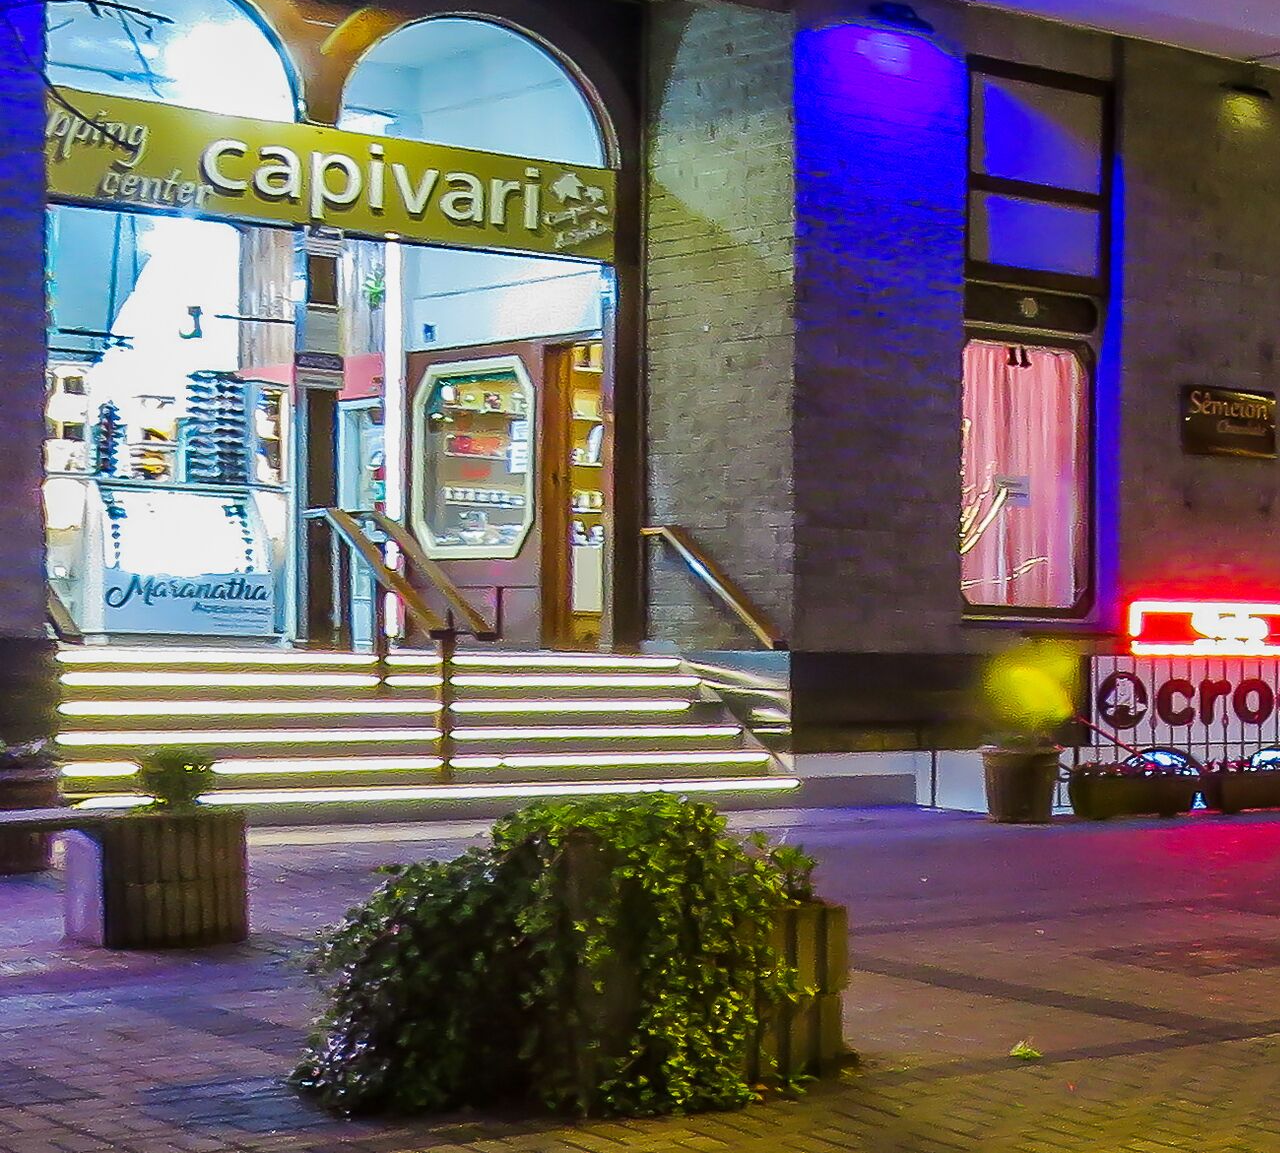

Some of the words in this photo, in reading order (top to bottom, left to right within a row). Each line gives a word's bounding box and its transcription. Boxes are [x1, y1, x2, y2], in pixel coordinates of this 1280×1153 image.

[99, 168, 214, 208] center
[200, 138, 542, 232] capivari
[105, 574, 270, 608] Maranatha
